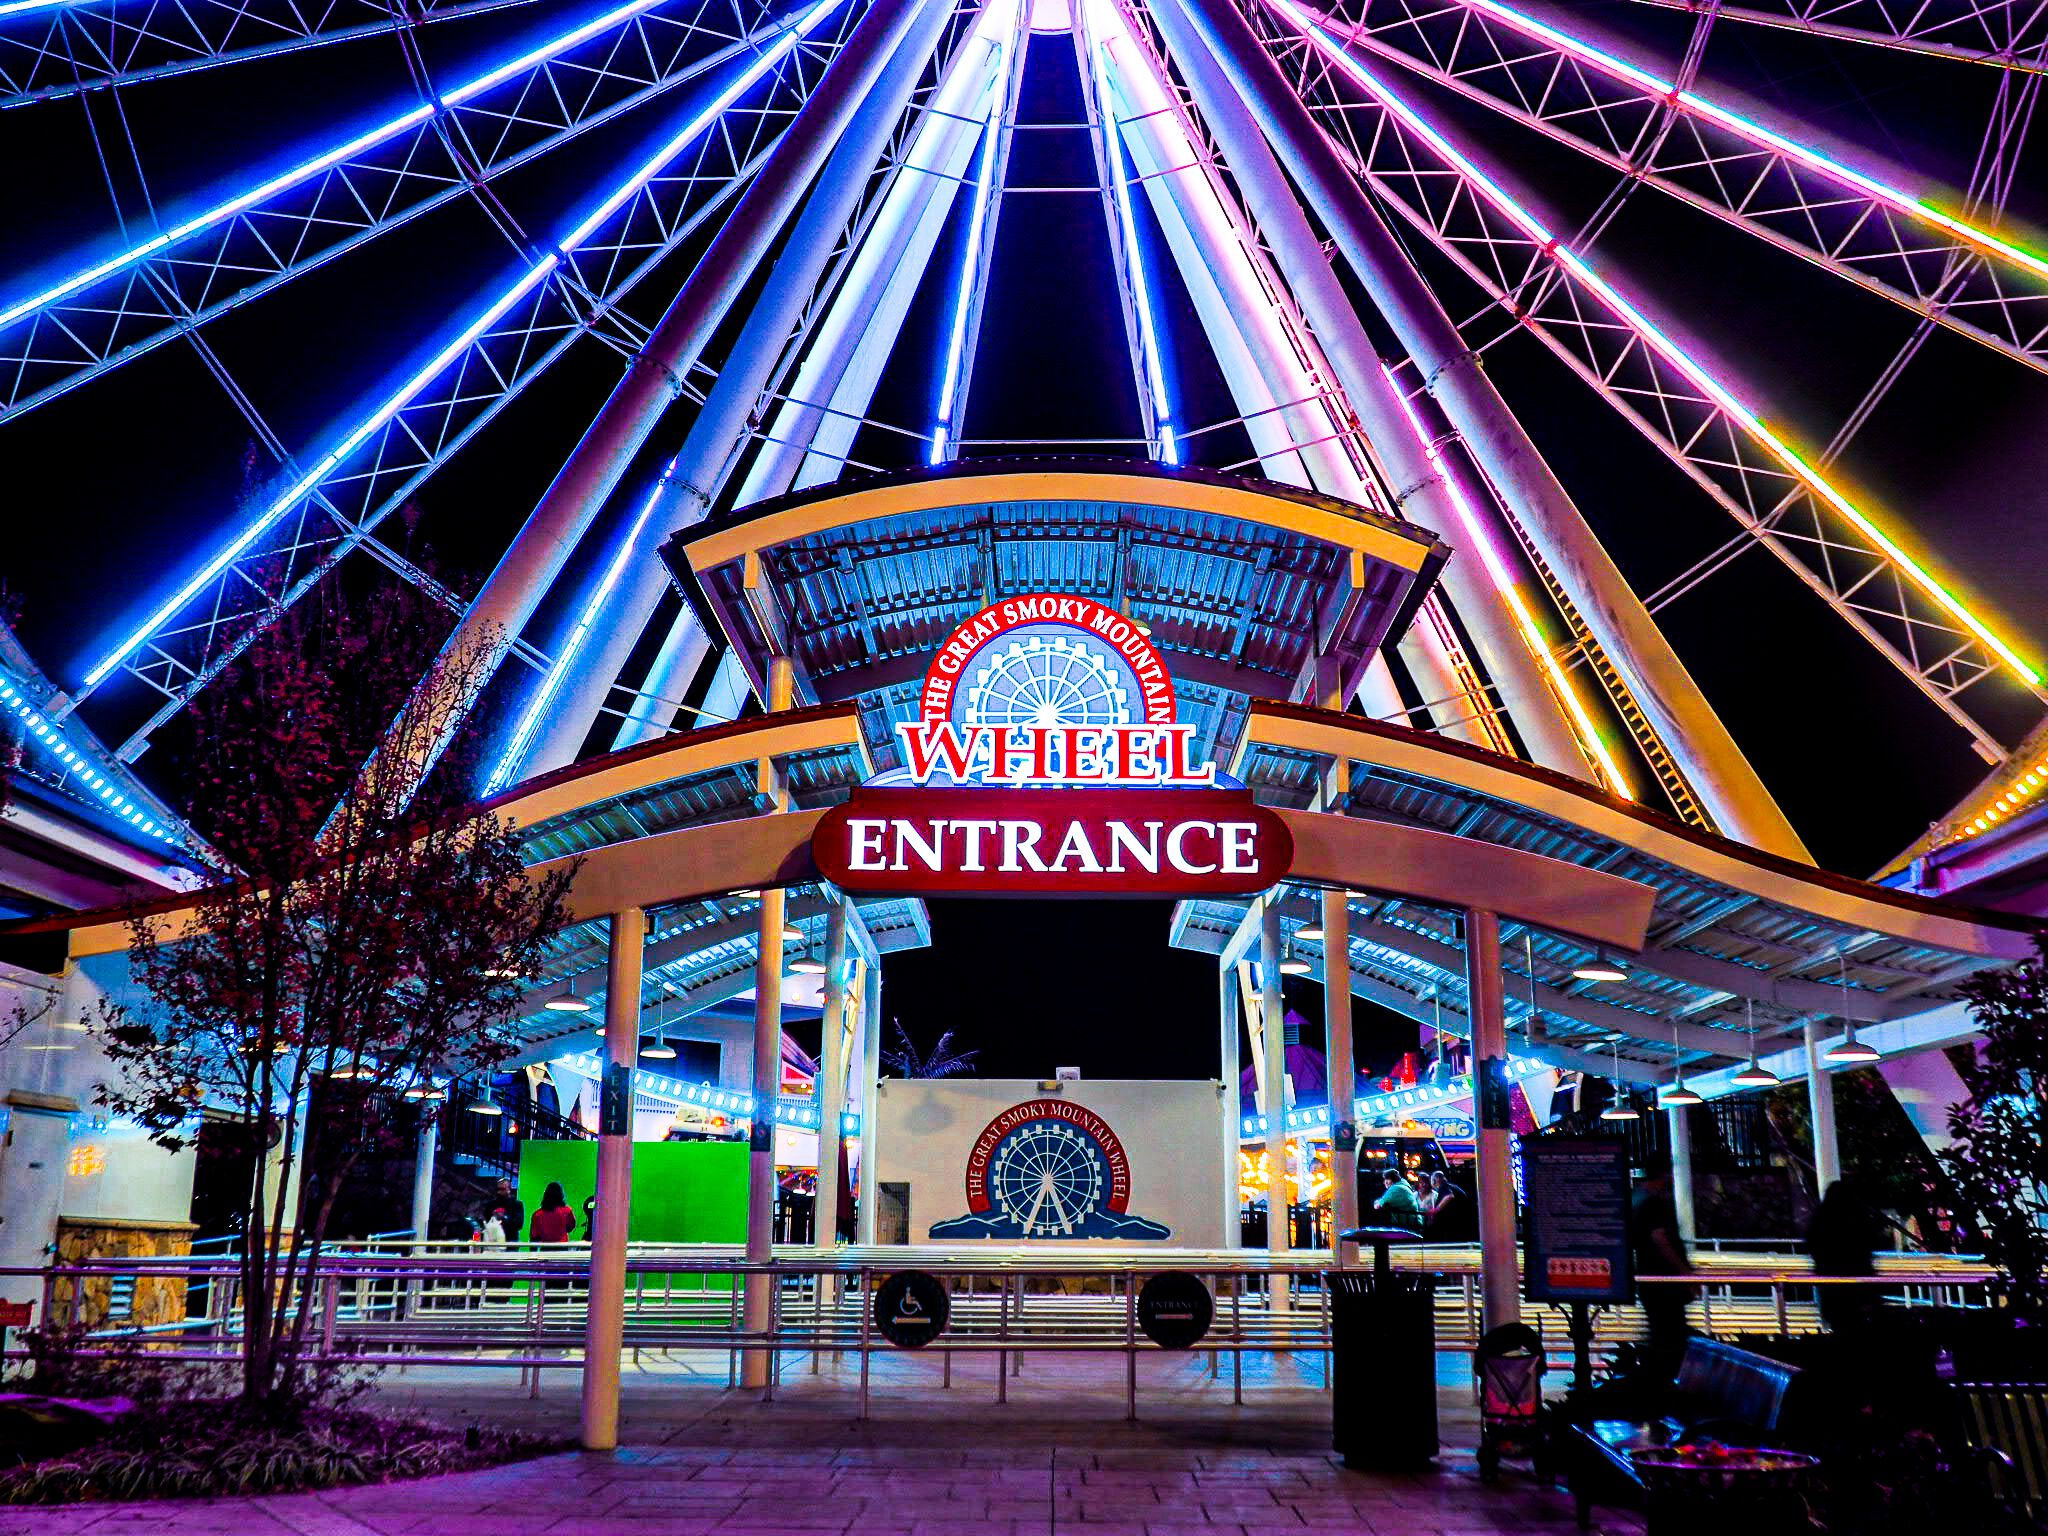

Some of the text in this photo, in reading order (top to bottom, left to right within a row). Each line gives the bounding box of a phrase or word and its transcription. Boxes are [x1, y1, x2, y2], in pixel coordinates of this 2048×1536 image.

[925, 597, 1171, 723] THE GREAT SMOKY MOUNTAIN
[896, 721, 1216, 785] WHEEL
[847, 819, 1259, 875] ENTRANCE
[608, 1075, 619, 1130] EXIT
[969, 1103, 1126, 1199] THE GREAT SMOKY MOUNTAIN WHEEL
